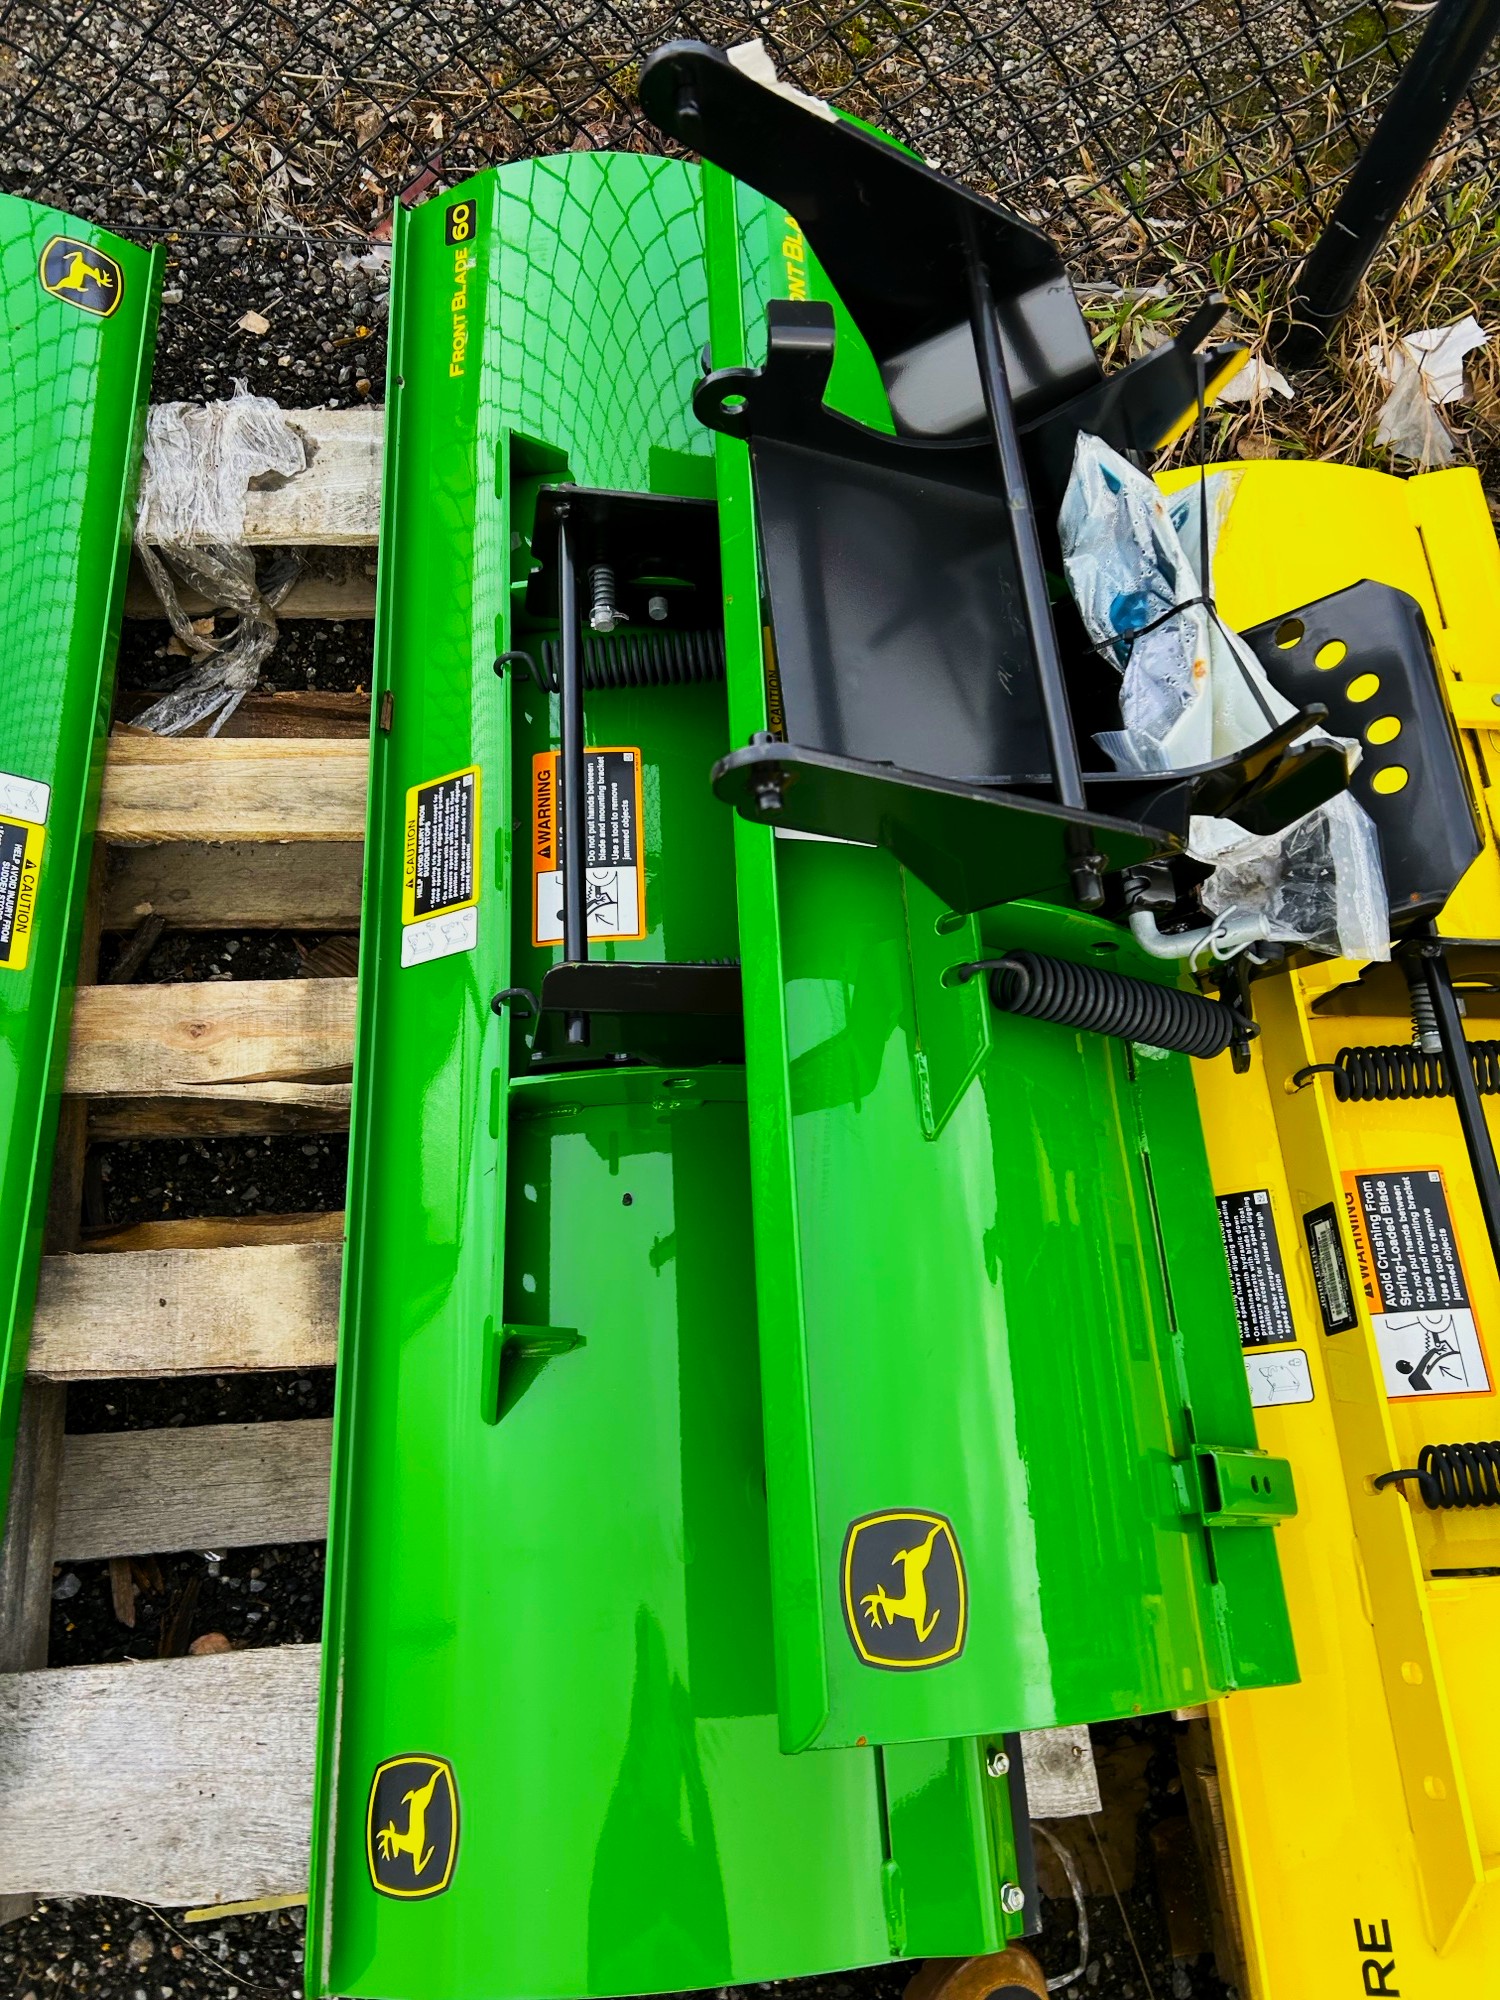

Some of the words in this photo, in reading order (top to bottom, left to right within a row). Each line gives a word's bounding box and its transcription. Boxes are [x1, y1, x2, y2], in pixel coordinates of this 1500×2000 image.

[452, 204, 469, 240] 60
[782, 216, 805, 262] BLA
[451, 248, 468, 311] BLADE
[449, 314, 466, 377] FRONT
[768, 669, 781, 725] CAUTION
[586, 762, 595, 795] between
[597, 756, 605, 784] bracket
[537, 770, 551, 845] WARNING
[587, 795, 595, 820] hands
[597, 785, 607, 822] mounting
[611, 812, 619, 821] to
[621, 799, 631, 828] objects
[587, 820, 597, 834] put
[598, 823, 606, 838] and
[611, 821, 619, 837] tool
[12, 843, 22, 865] HELP
[406, 819, 416, 875] CAUTION
[587, 835, 596, 849] not
[587, 850, 596, 862] Do
[598, 839, 606, 861] blade
[611, 844, 620, 860] Use
[622, 829, 632, 860] jammed
[0, 861, 11, 893] SUDDEN
[8, 865, 19, 889] AVOID
[4, 890, 15, 919] INJURY
[16, 875, 35, 933] CAUTION
[0, 919, 11, 943] FROM
[1363, 1181, 1377, 1211] From
[1376, 1181, 1392, 1214] Blade
[1393, 1185, 1407, 1222] between
[1402, 1176, 1416, 1210] bracket
[1401, 1224, 1414, 1252] hands
[1411, 1211, 1426, 1255] mounting
[1423, 1207, 1437, 1241] remove
[1370, 1214, 1389, 1269] Crushing
[1431, 1243, 1440, 1253] to
[1439, 1228, 1453, 1262] objects
[1383, 1217, 1412, 1306] Spring-Loaded
[1407, 1254, 1420, 1270] put
[1419, 1256, 1431, 1274] and
[1432, 1254, 1444, 1273] tool
[1380, 1272, 1398, 1307] Avoid
[1411, 1271, 1422, 1287] not
[1425, 1276, 1437, 1302] blade
[1440, 1282, 1451, 1301] Use
[1446, 1263, 1464, 1301] jammed
[1416, 1289, 1426, 1303] Do
